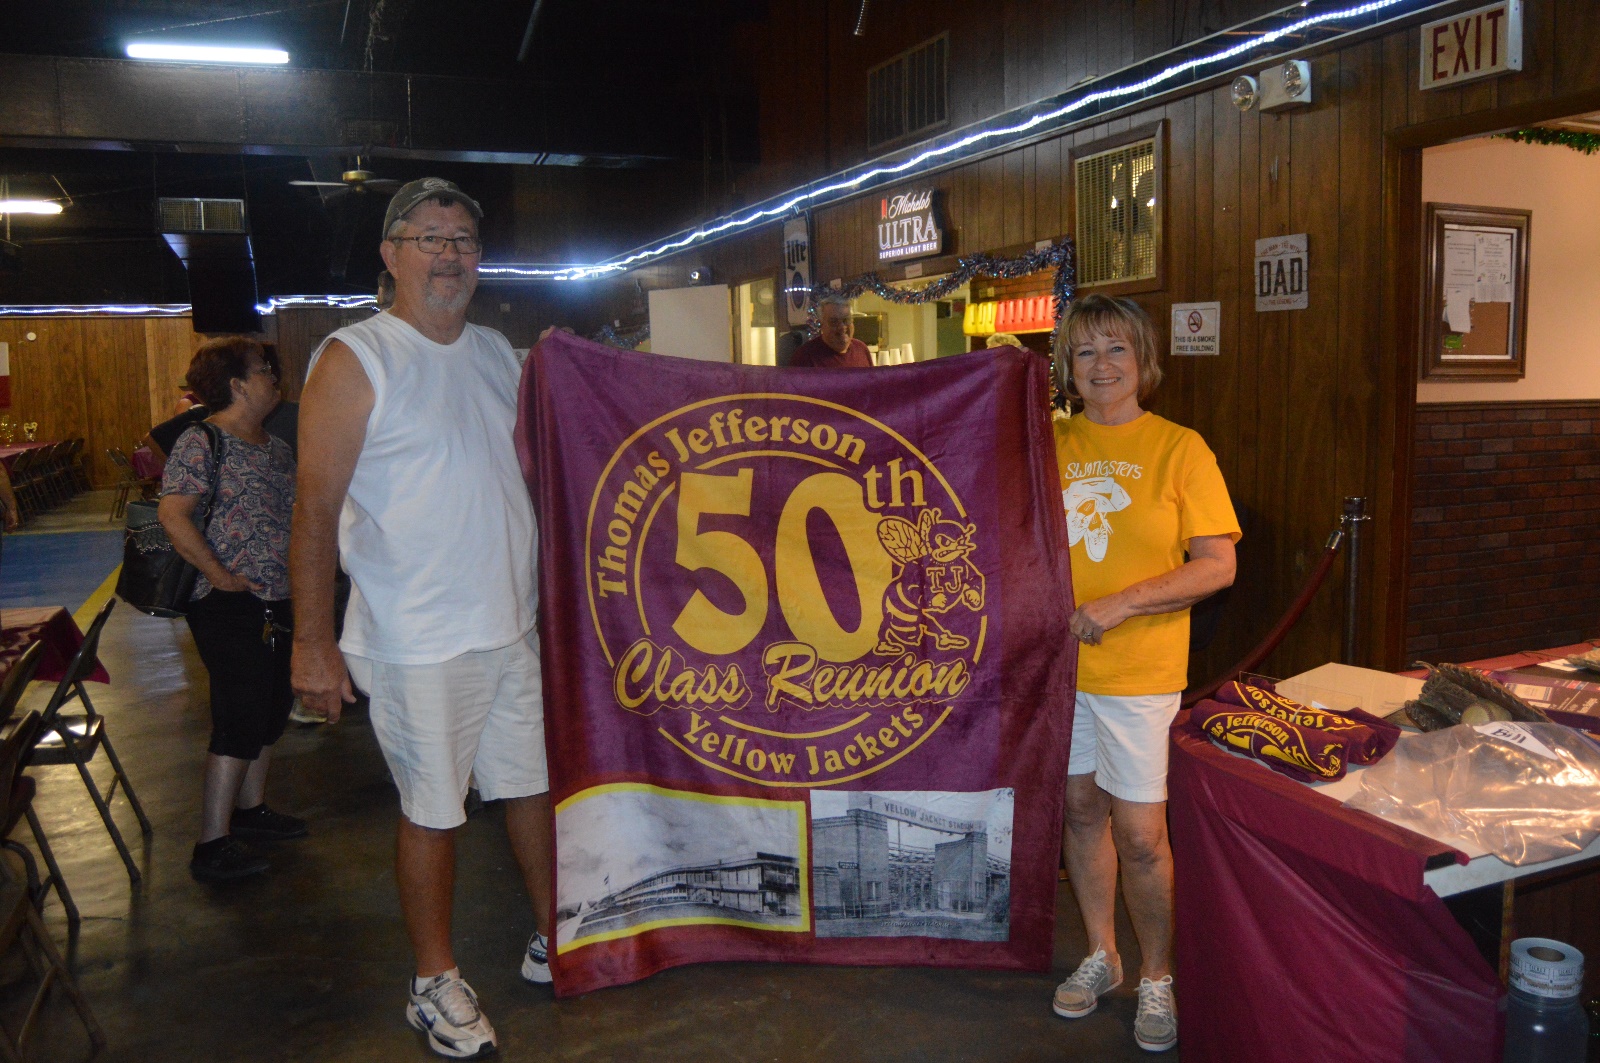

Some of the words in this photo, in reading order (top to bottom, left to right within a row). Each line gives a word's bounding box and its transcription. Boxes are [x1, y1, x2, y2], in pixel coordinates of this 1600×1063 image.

[1432, 8, 1504, 81] EXIT
[888, 190, 932, 219] Michelob
[878, 212, 938, 250] ULTRA
[785, 239, 807, 271] Lite
[879, 248, 904, 260] SUPERIOR
[905, 244, 921, 255] LIGHT
[922, 241, 937, 252] BEER
[1259, 257, 1303, 297] DAD
[1197, 335, 1216, 343] SMOKE
[598, 449, 671, 599] Thomas
[664, 409, 867, 466] Jefferson
[926, 565, 962, 594] TJ
[615, 639, 749, 712] Class
[763, 641, 967, 711] Reunion
[682, 711, 796, 775] Yellow
[807, 706, 925, 776] Jackets
[1226, 715, 1290, 744] Jefferson
[884, 802, 918, 819] YELLOW
[919, 813, 946, 827] JACKET
